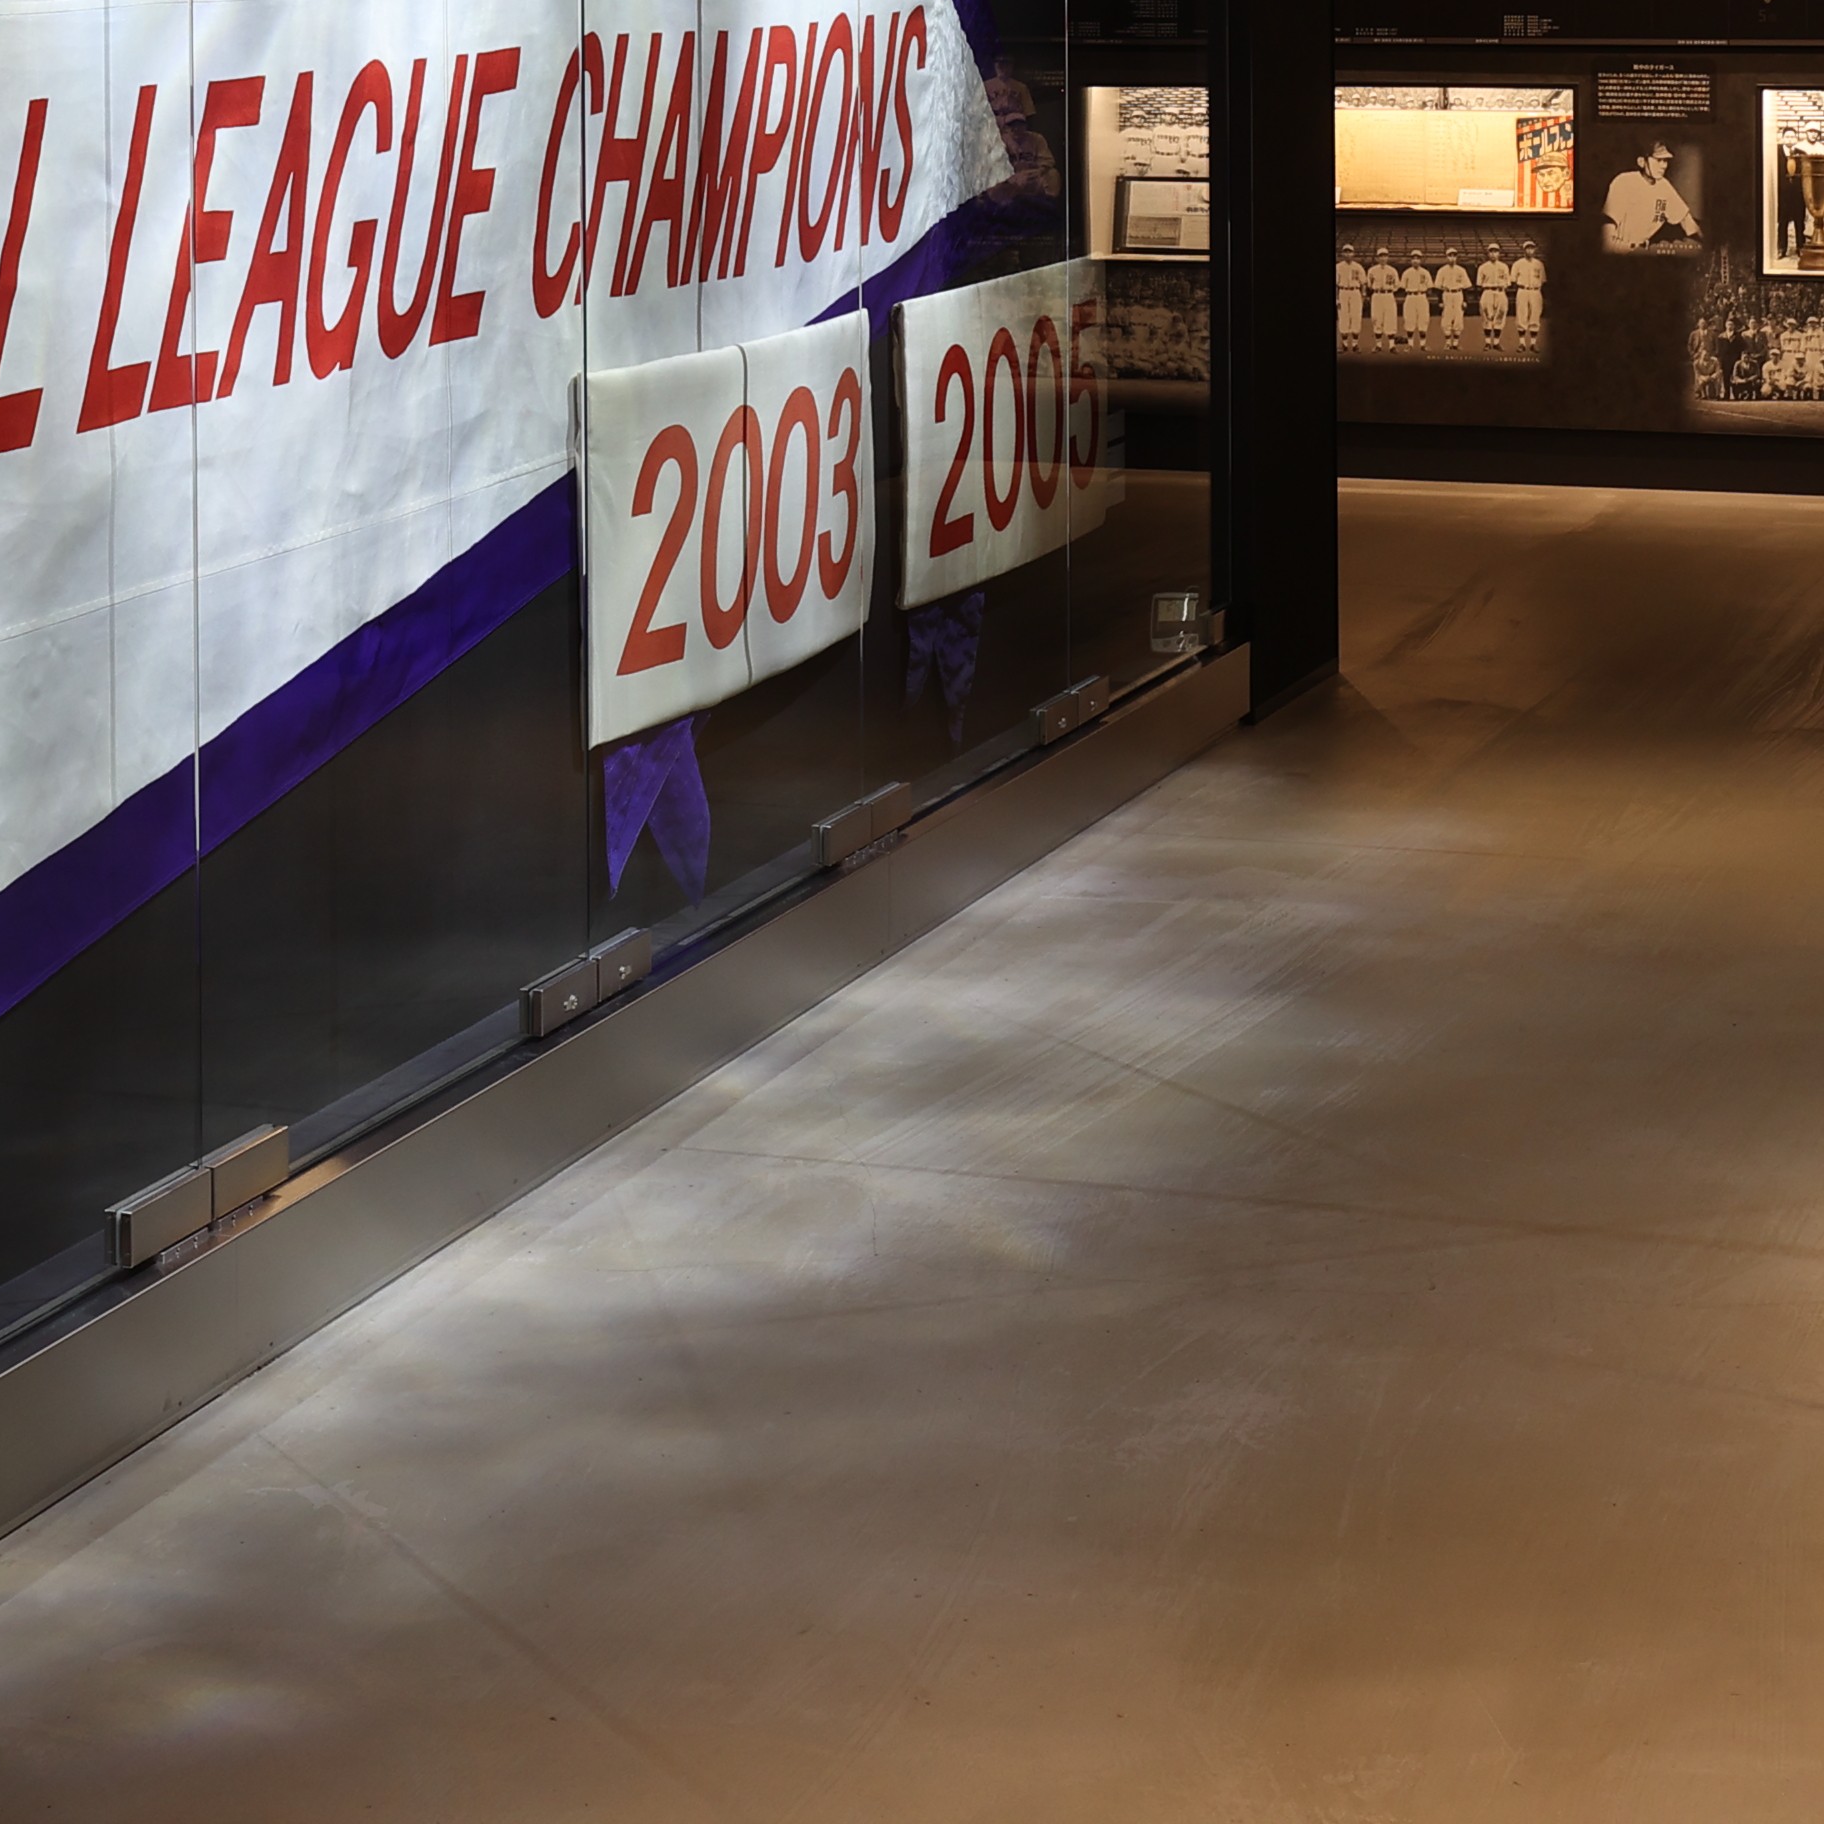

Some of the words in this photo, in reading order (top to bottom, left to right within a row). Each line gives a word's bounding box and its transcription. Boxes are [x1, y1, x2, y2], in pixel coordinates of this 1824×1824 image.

[76, 48, 520, 435] LEAGUE
[532, 5, 926, 319] CHAMPIONS
[616, 366, 862, 676] 2003
[929, 297, 1098, 559] 2005
